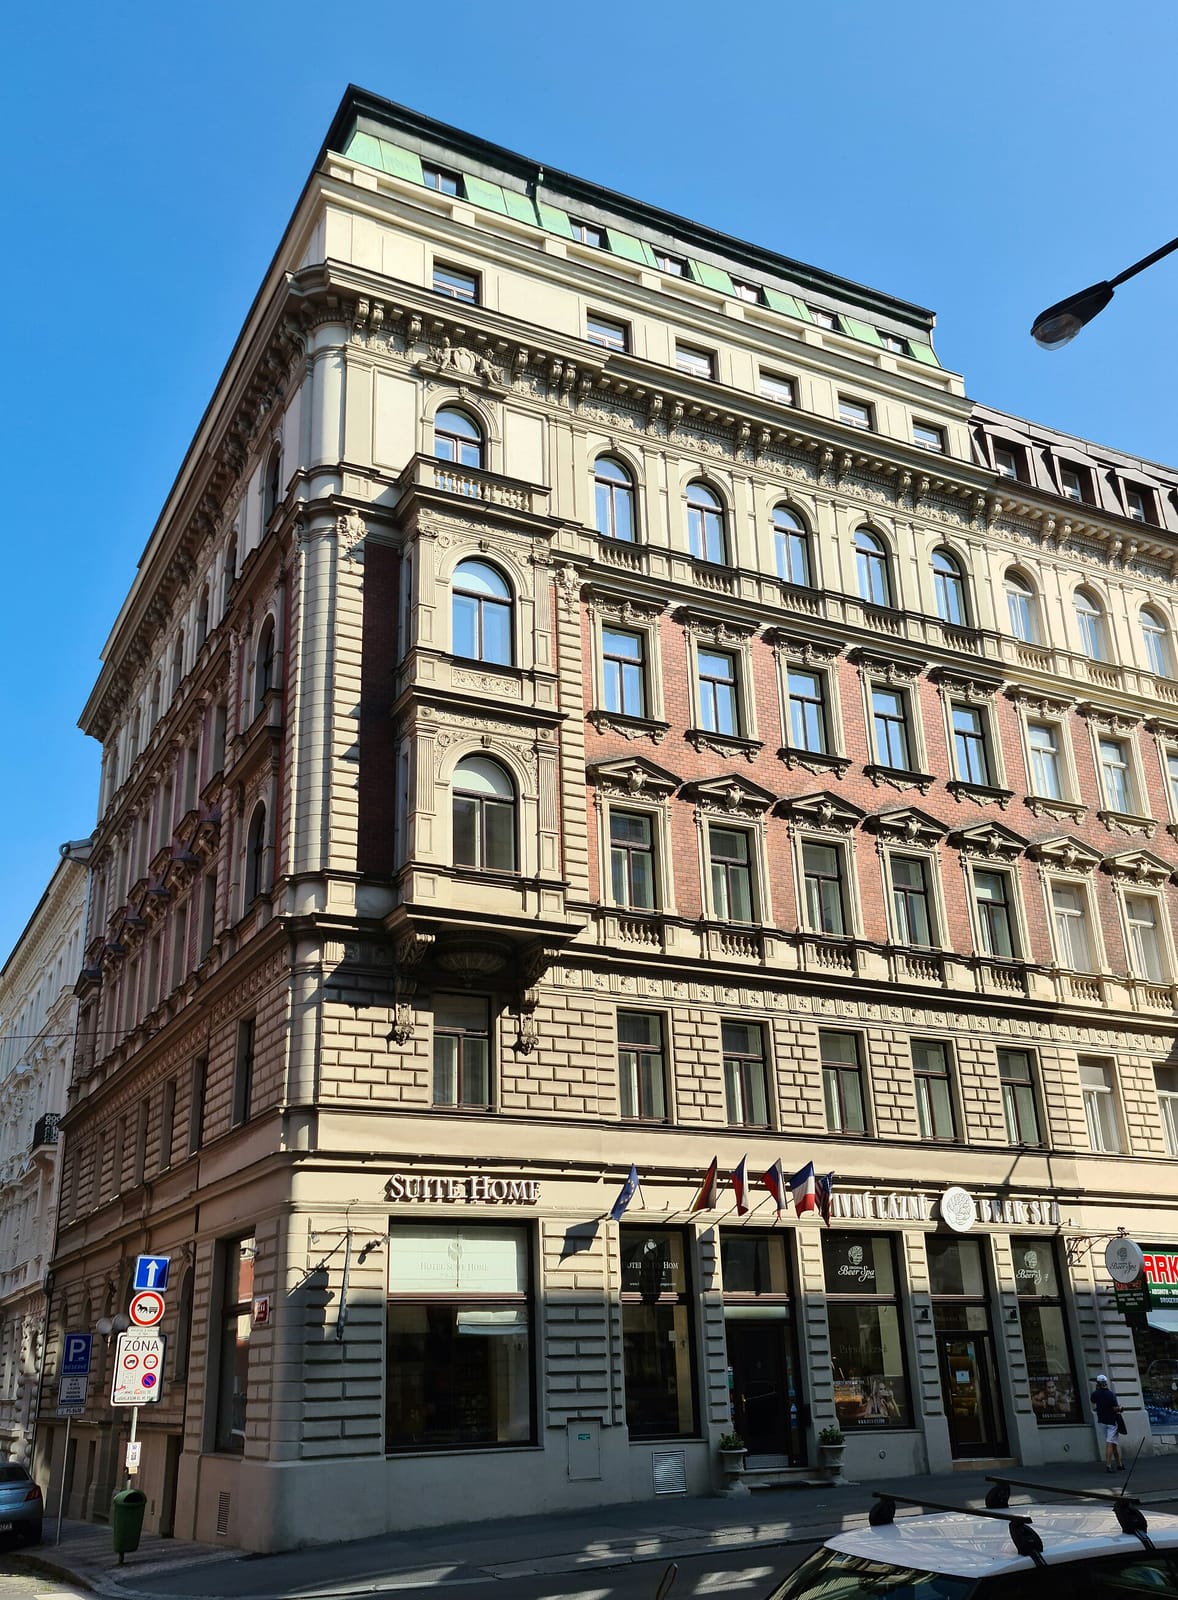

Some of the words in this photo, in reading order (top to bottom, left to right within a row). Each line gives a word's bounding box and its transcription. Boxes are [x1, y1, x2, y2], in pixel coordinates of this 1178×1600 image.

[390, 1173, 462, 1199] SUITE
[469, 1175, 542, 1201] HOME
[830, 1191, 874, 1218] IVNÍ
[980, 1199, 1029, 1224] BEER
[68, 1338, 86, 1362] P
[124, 1336, 160, 1352] ZÓNA
